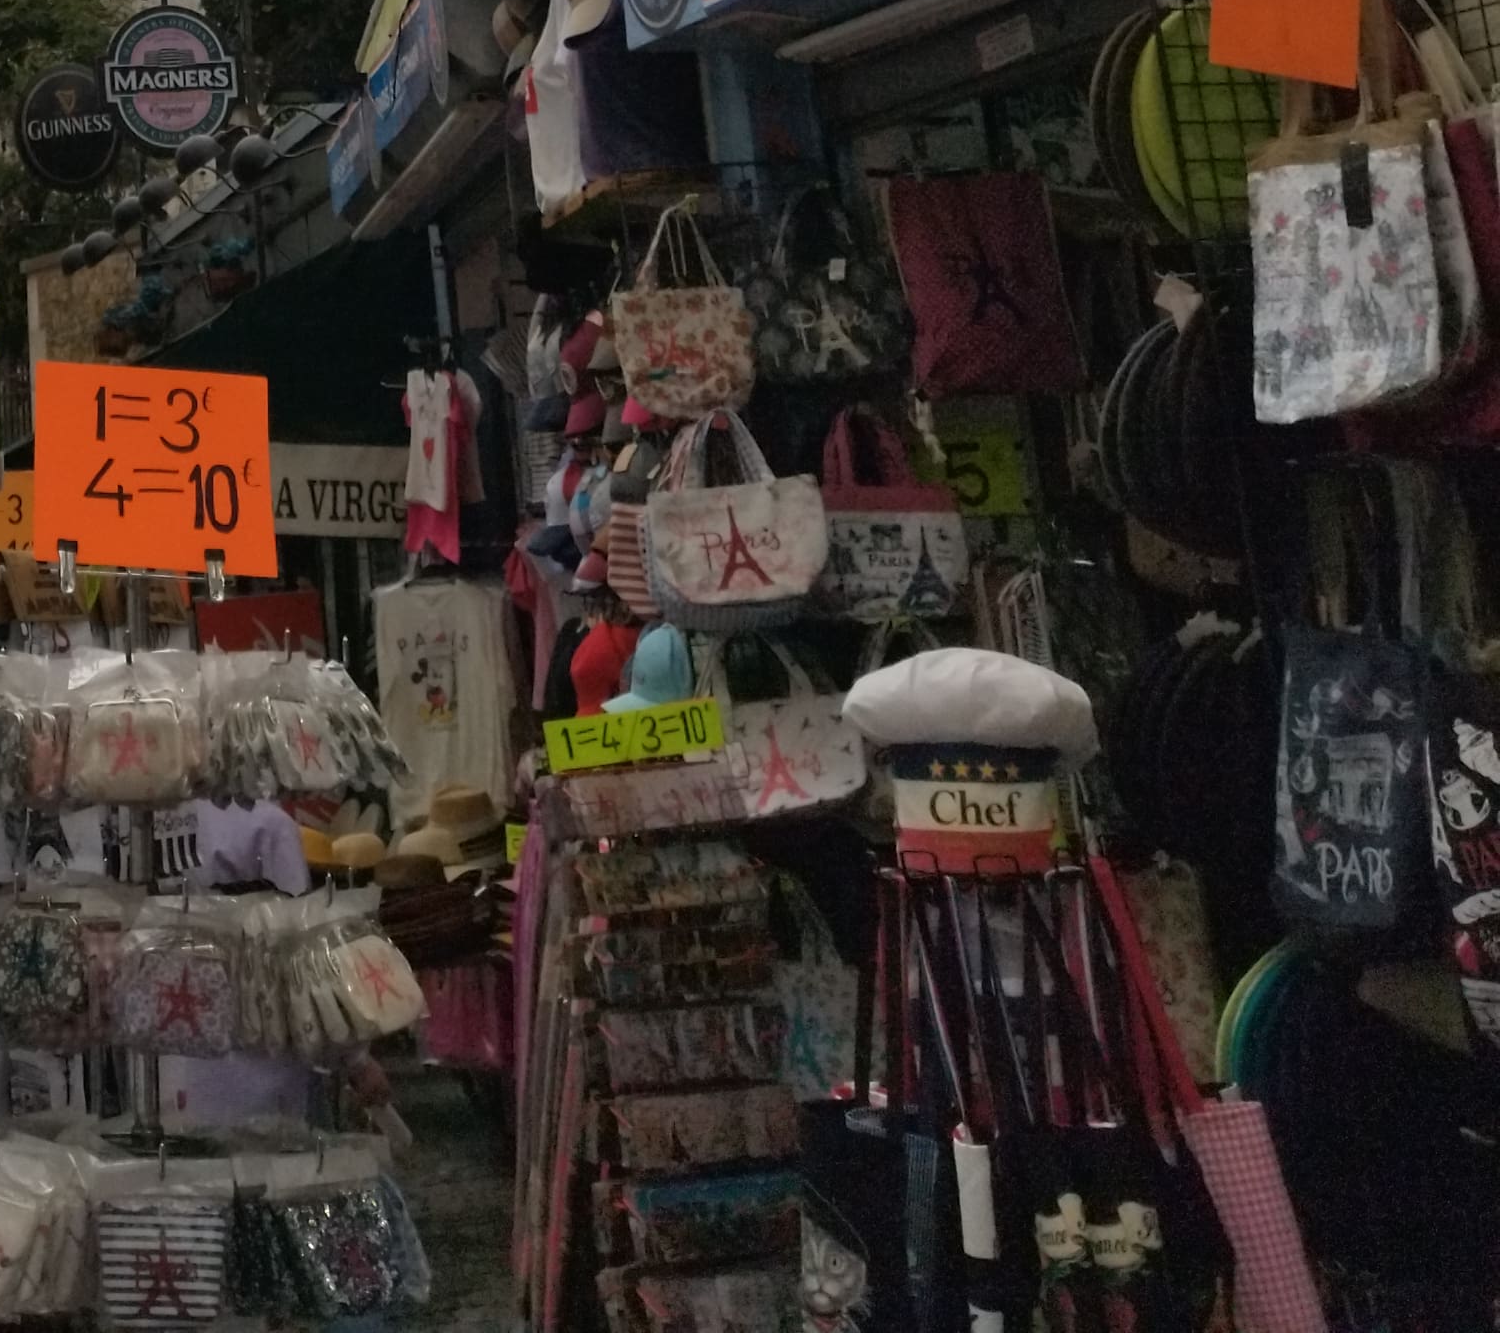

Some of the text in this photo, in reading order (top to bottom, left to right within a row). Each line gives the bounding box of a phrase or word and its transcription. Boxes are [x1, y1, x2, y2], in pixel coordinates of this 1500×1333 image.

[113, 66, 230, 92] MAGNERS
[27, 114, 112, 141] GUINNESS
[868, 553, 912, 568] PARIS
[929, 790, 1022, 827] Chef
